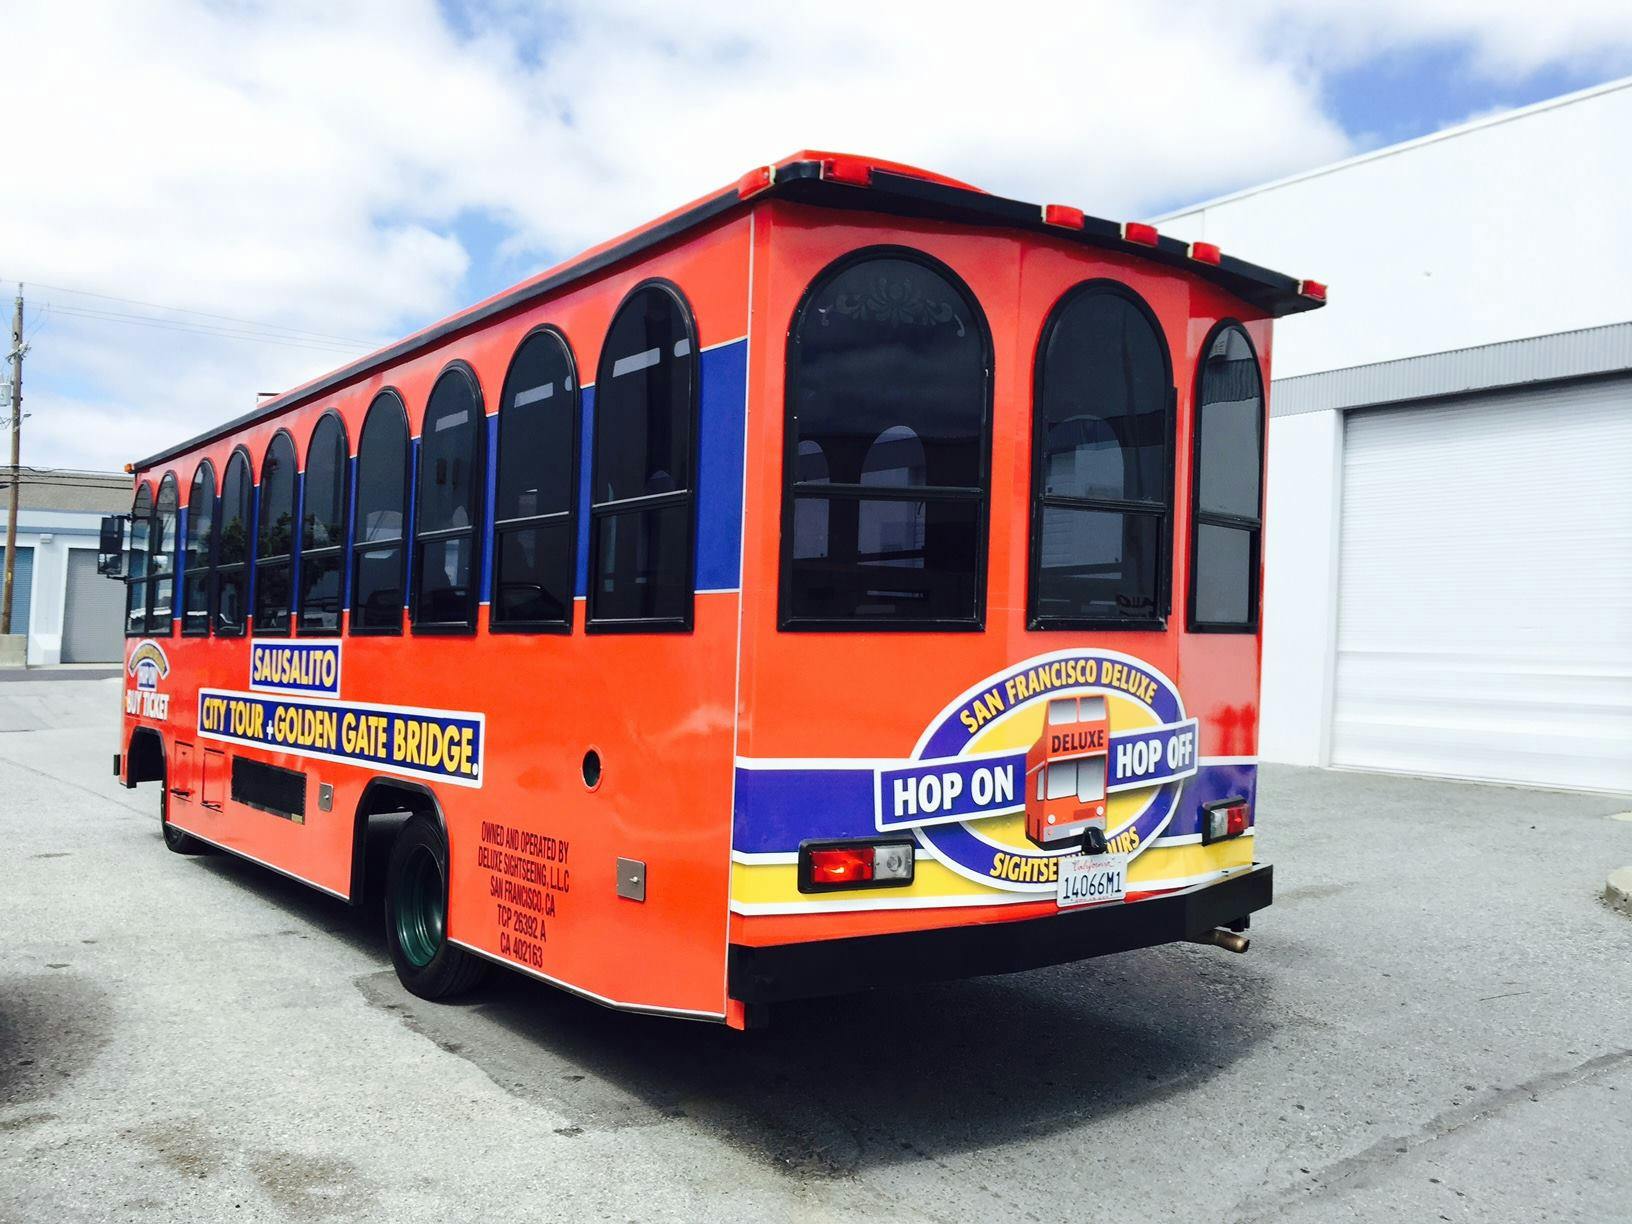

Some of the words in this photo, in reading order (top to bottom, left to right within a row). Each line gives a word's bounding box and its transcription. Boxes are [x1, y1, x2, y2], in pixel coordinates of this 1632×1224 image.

[253, 649, 336, 687] SAUSALITO
[960, 690, 1004, 733] SAN
[1005, 659, 1097, 703] FRANCISCO
[1101, 661, 1158, 705] DELUXE
[203, 697, 227, 732] CITY
[230, 703, 264, 738] TOUR
[274, 706, 338, 749] GOLDEN
[342, 712, 387, 757] GATE
[1051, 729, 1104, 753] DELUXE
[1116, 739, 1162, 779] HOP
[1166, 732, 1193, 769] OFF
[893, 773, 963, 817] HOP
[971, 764, 1014, 803] ON
[478, 845, 503, 873] DELUXE
[482, 820, 505, 846] OWNED
[506, 827, 519, 851] AND
[520, 830, 556, 861] OPERATED
[558, 840, 569, 865] BY
[989, 852, 1078, 883] SIGHTSE
[1063, 871, 1122, 899] 14066M1
[490, 875, 503, 900] SAN
[545, 892, 556, 918] CA
[497, 903, 512, 929] TCP
[513, 910, 538, 940] 26392
[540, 919, 547, 943] A
[500, 931, 511, 956] CA
[512, 936, 543, 969] 402163
